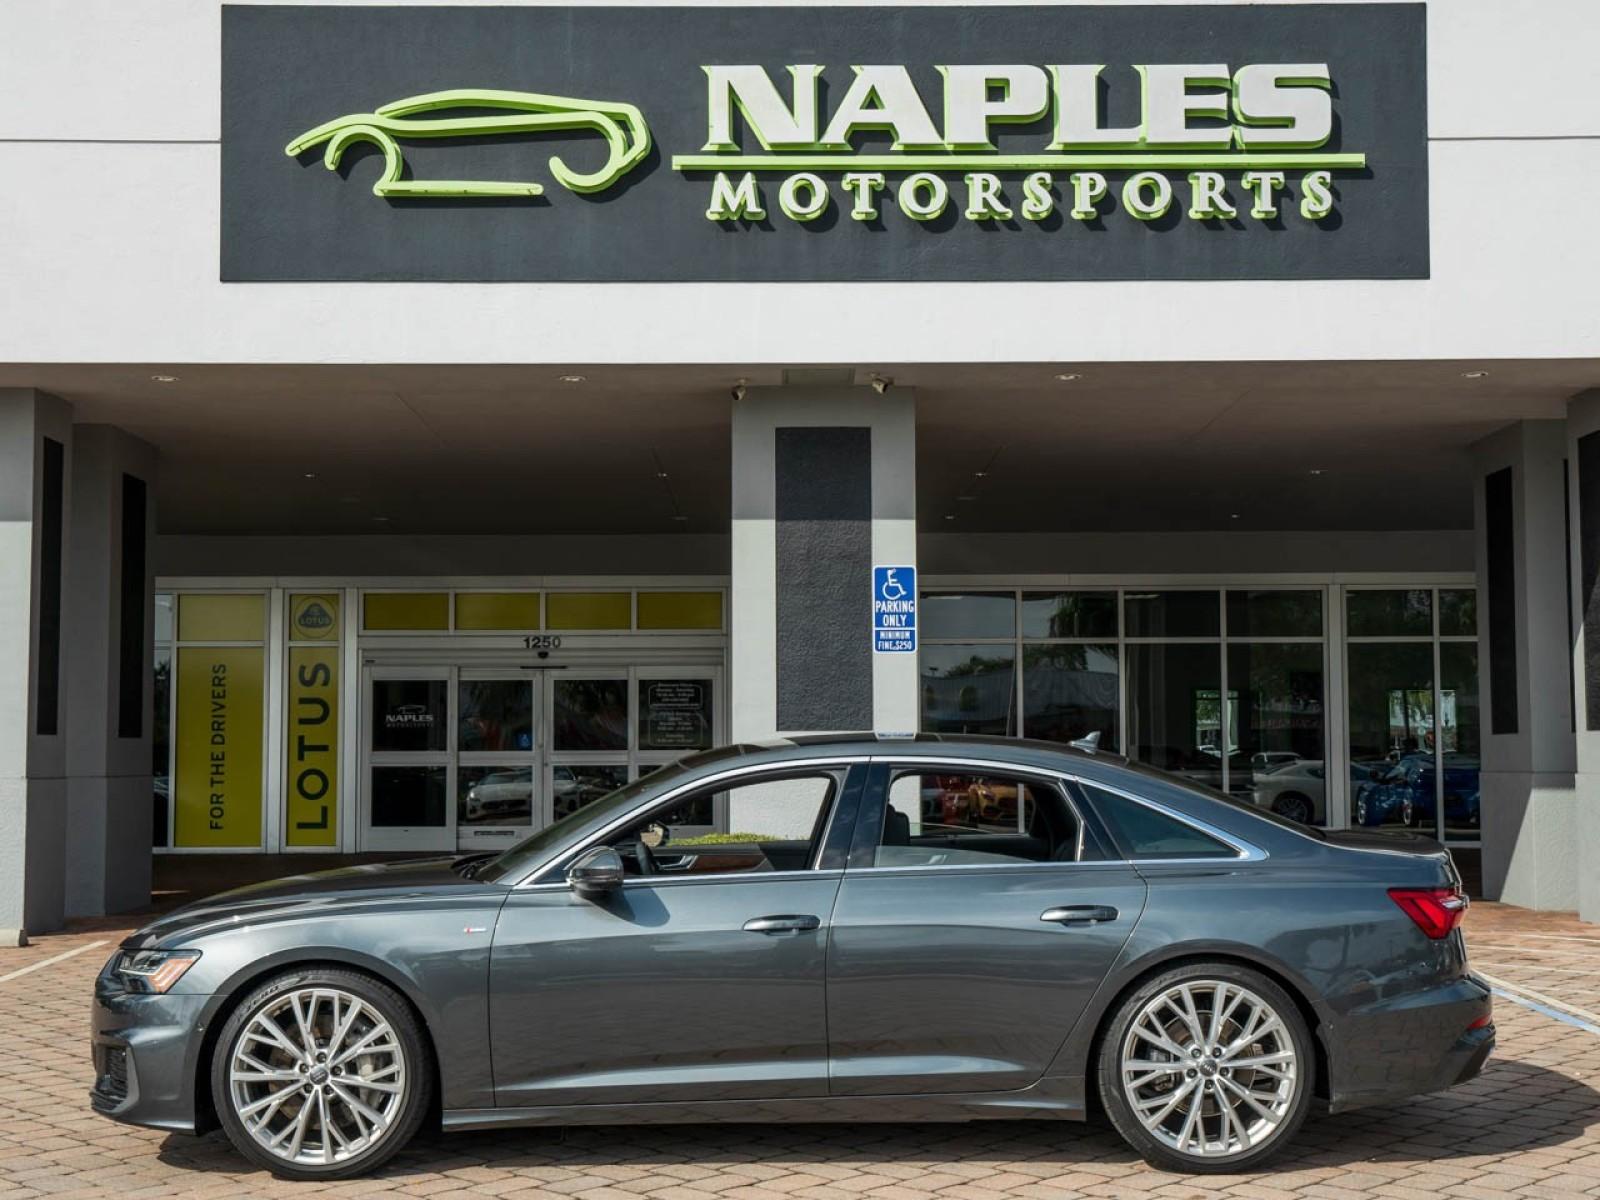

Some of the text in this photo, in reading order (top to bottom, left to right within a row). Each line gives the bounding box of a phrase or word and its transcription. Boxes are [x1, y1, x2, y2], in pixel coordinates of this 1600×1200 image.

[700, 63, 1332, 152] NAPLES
[706, 171, 1334, 221] MOTORSPORTS
[876, 601, 915, 613] PARKING
[301, 616, 330, 625] LOTUS
[883, 614, 907, 627] ONLY
[523, 635, 562, 649] 1250
[880, 631, 911, 640] MINIMUM
[385, 714, 434, 722] NAPLES
[210, 663, 227, 830] FOR THE DRIVERS
[296, 662, 331, 830] LOTUS
